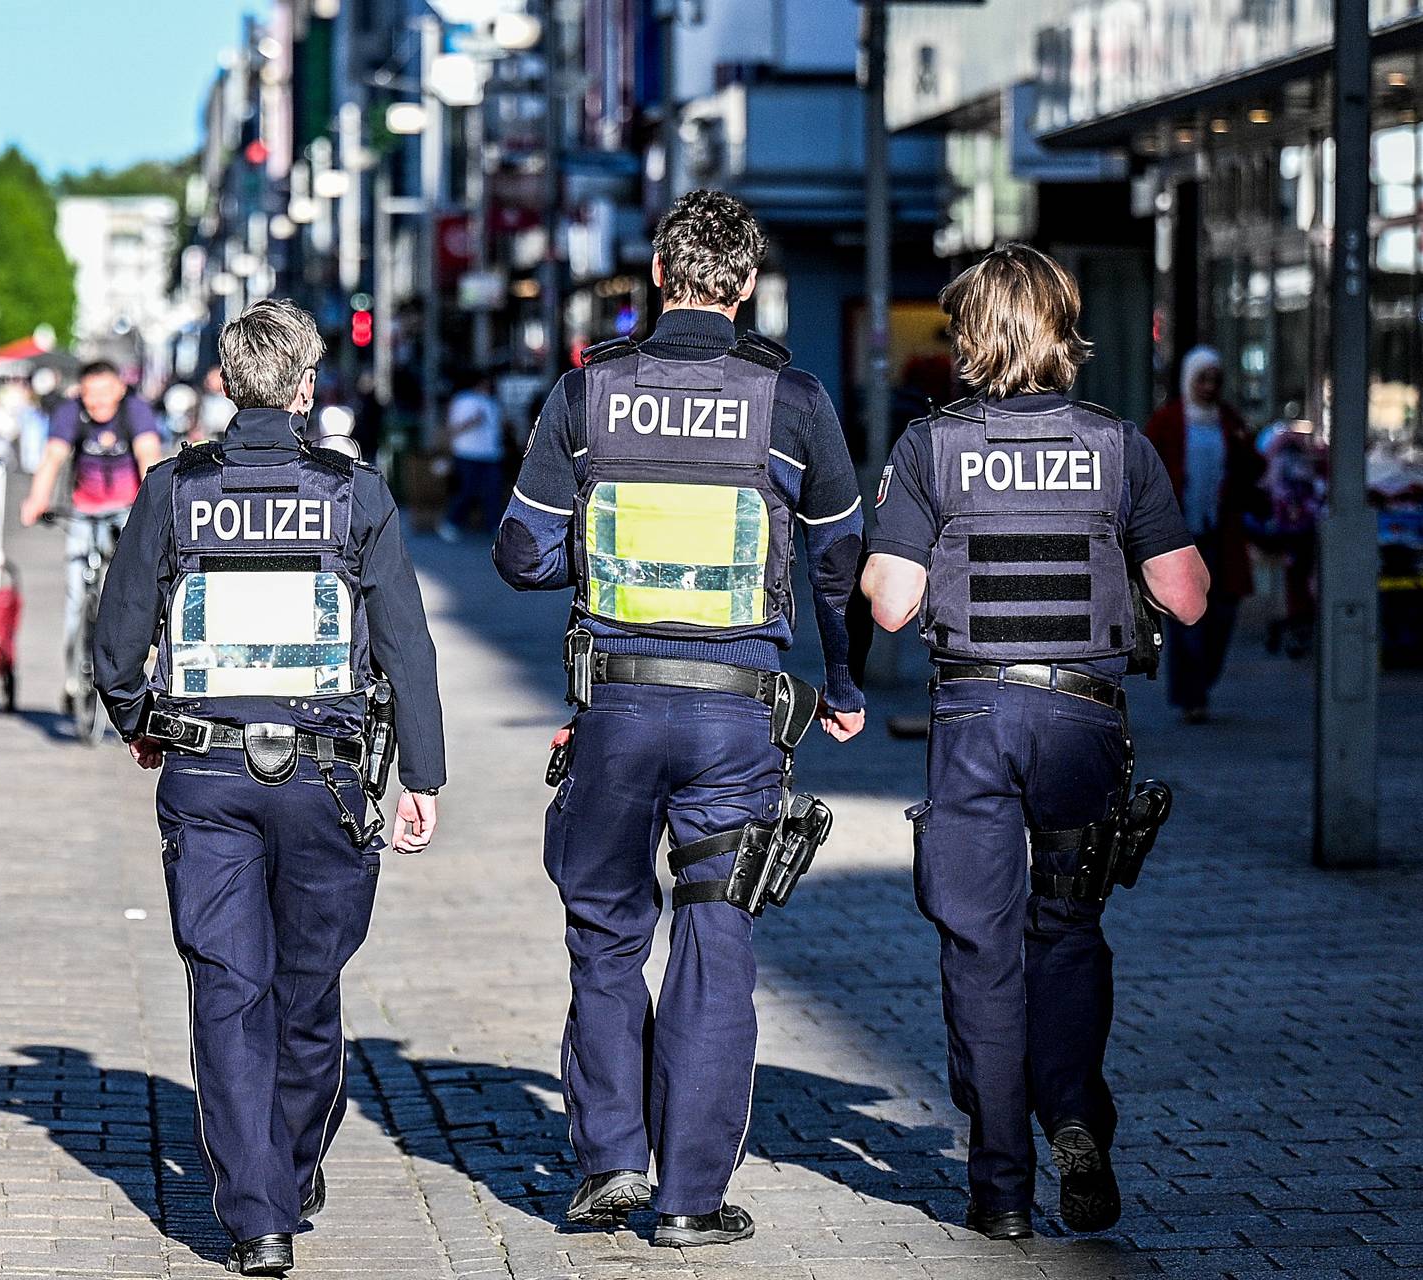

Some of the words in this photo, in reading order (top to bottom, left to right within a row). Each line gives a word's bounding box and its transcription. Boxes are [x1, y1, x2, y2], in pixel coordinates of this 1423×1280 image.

[608, 393, 749, 439] POLIZEI
[960, 450, 1101, 491] POLIZEI
[190, 499, 331, 541] POLIZEI
